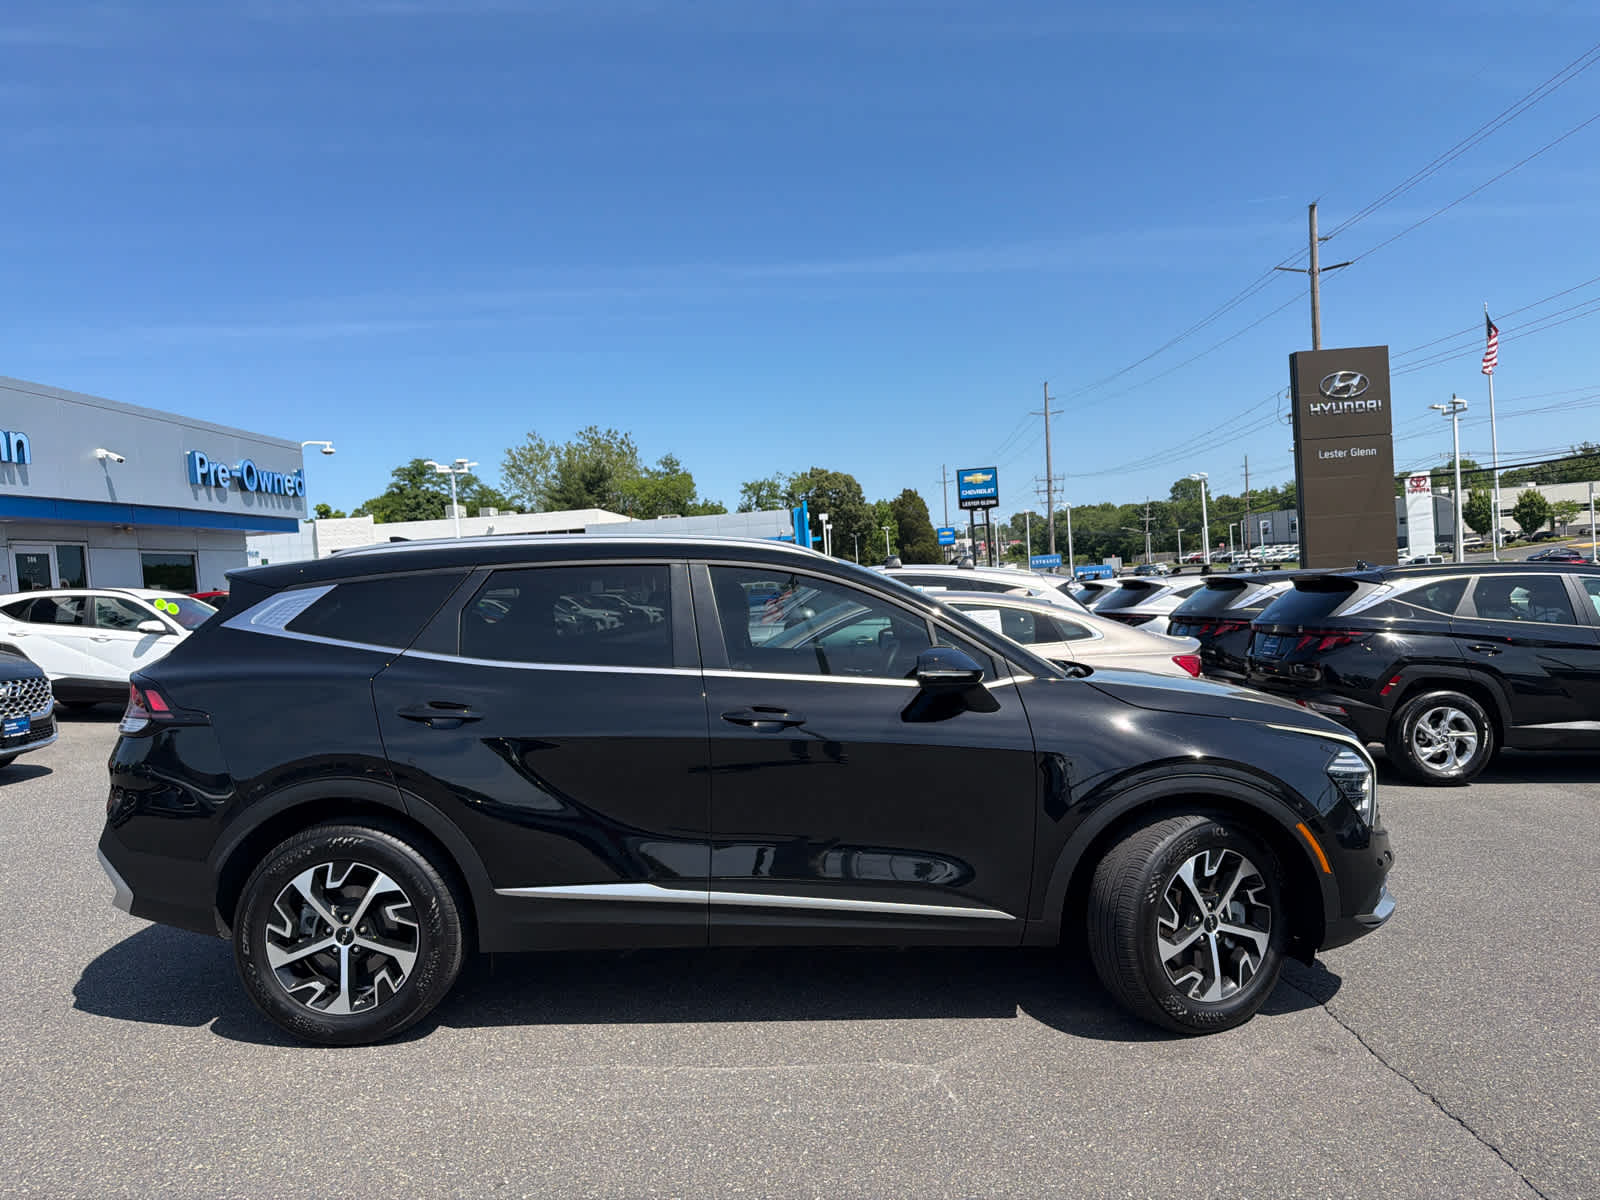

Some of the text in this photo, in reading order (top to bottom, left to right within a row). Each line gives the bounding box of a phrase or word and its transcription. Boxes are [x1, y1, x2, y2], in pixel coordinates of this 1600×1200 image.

[1310, 400, 1382, 414] HYUNDAI
[1319, 447, 1377, 459] Lester Glenn
[188, 450, 306, 497] Pre-Owned
[961, 487, 995, 496] CHEVROLET
